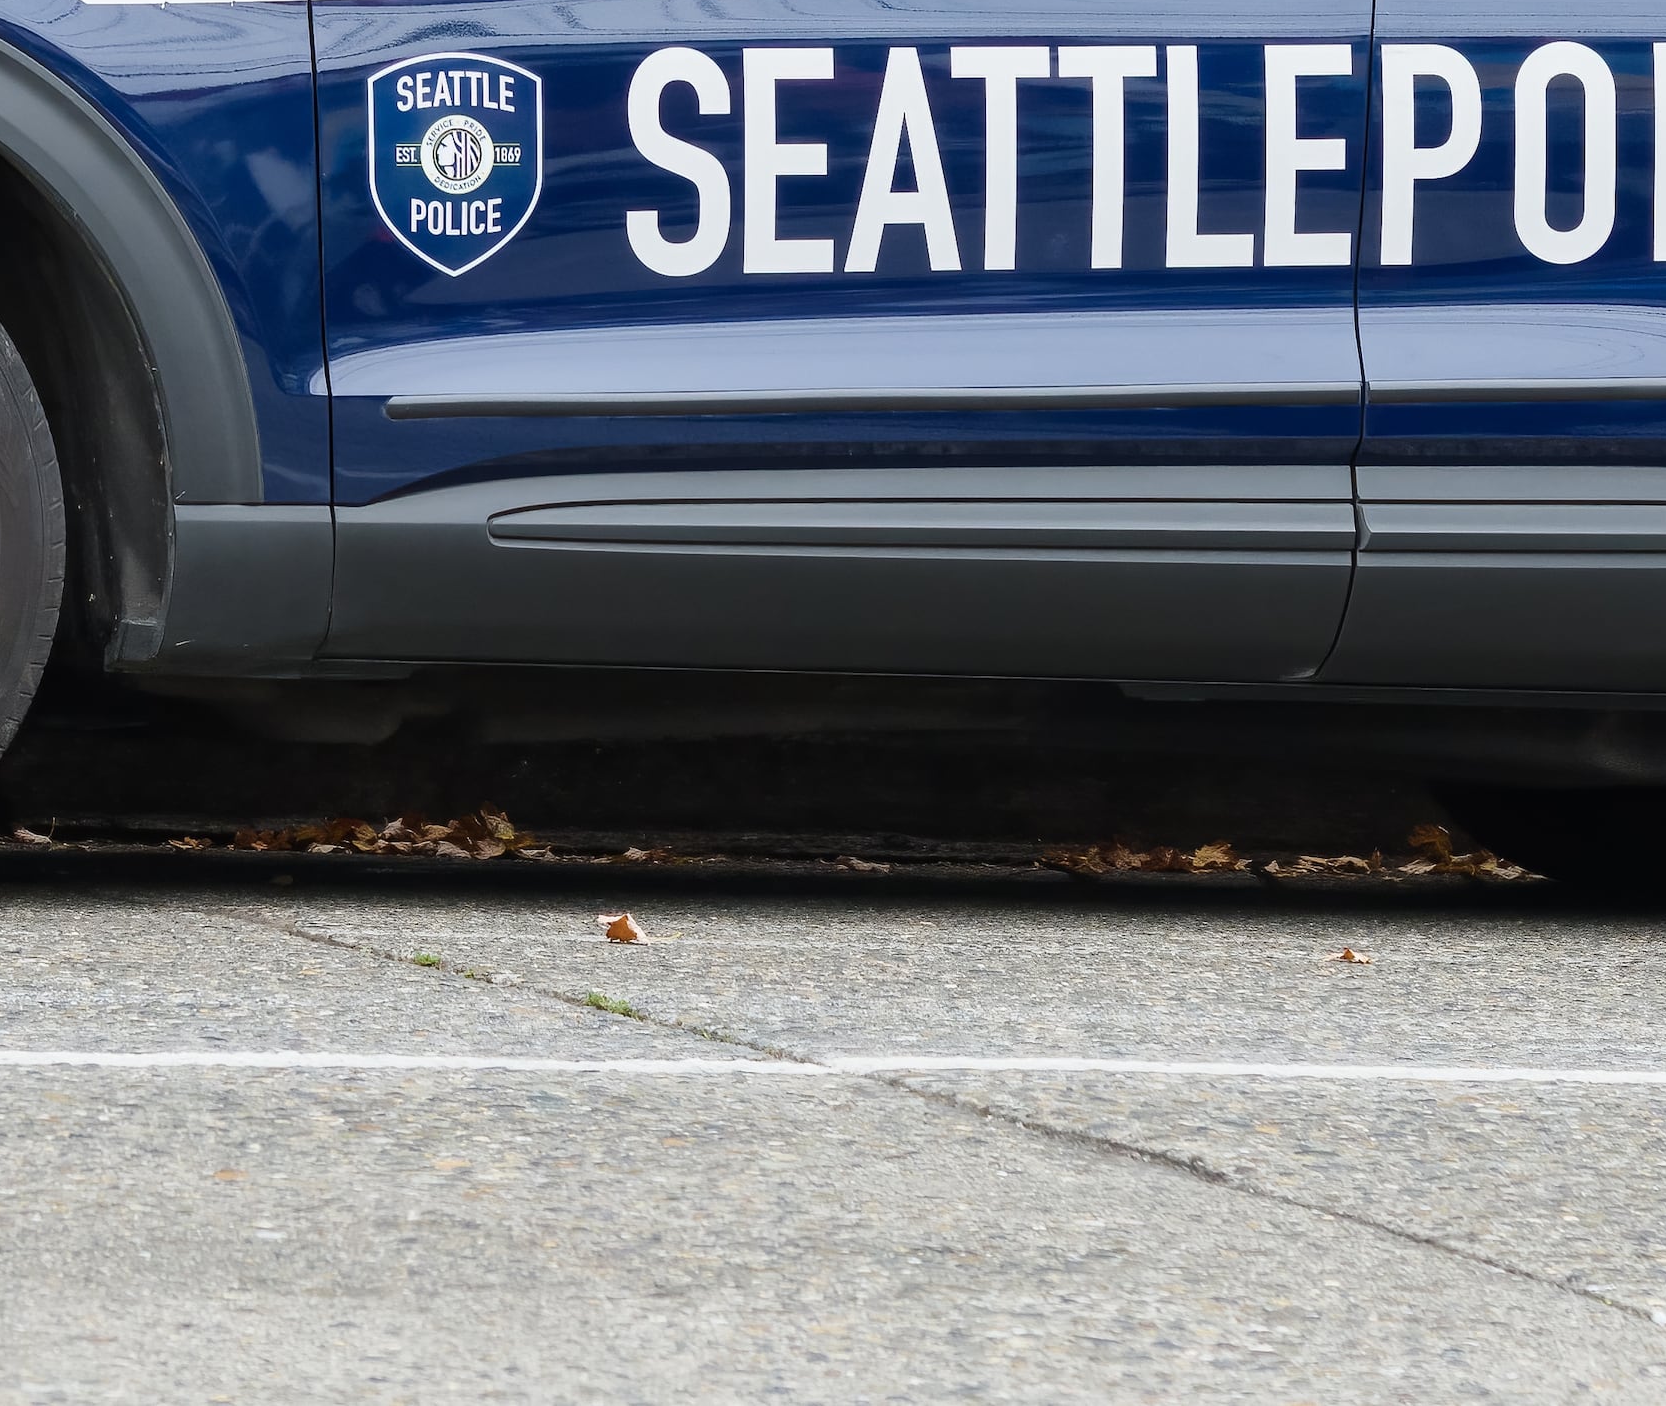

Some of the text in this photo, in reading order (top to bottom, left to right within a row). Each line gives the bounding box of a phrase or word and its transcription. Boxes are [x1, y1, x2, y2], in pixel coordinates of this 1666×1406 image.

[396, 70, 515, 112] SEATTLE
[426, 119, 453, 146] SERVICE
[463, 120, 487, 142] PRIDE
[397, 147, 417, 163] EST.
[494, 146, 521, 163] 1869
[626, 44, 1353, 276] SEATTLE
[433, 174, 483, 192] DEDICATION
[410, 197, 502, 236] POLICE
